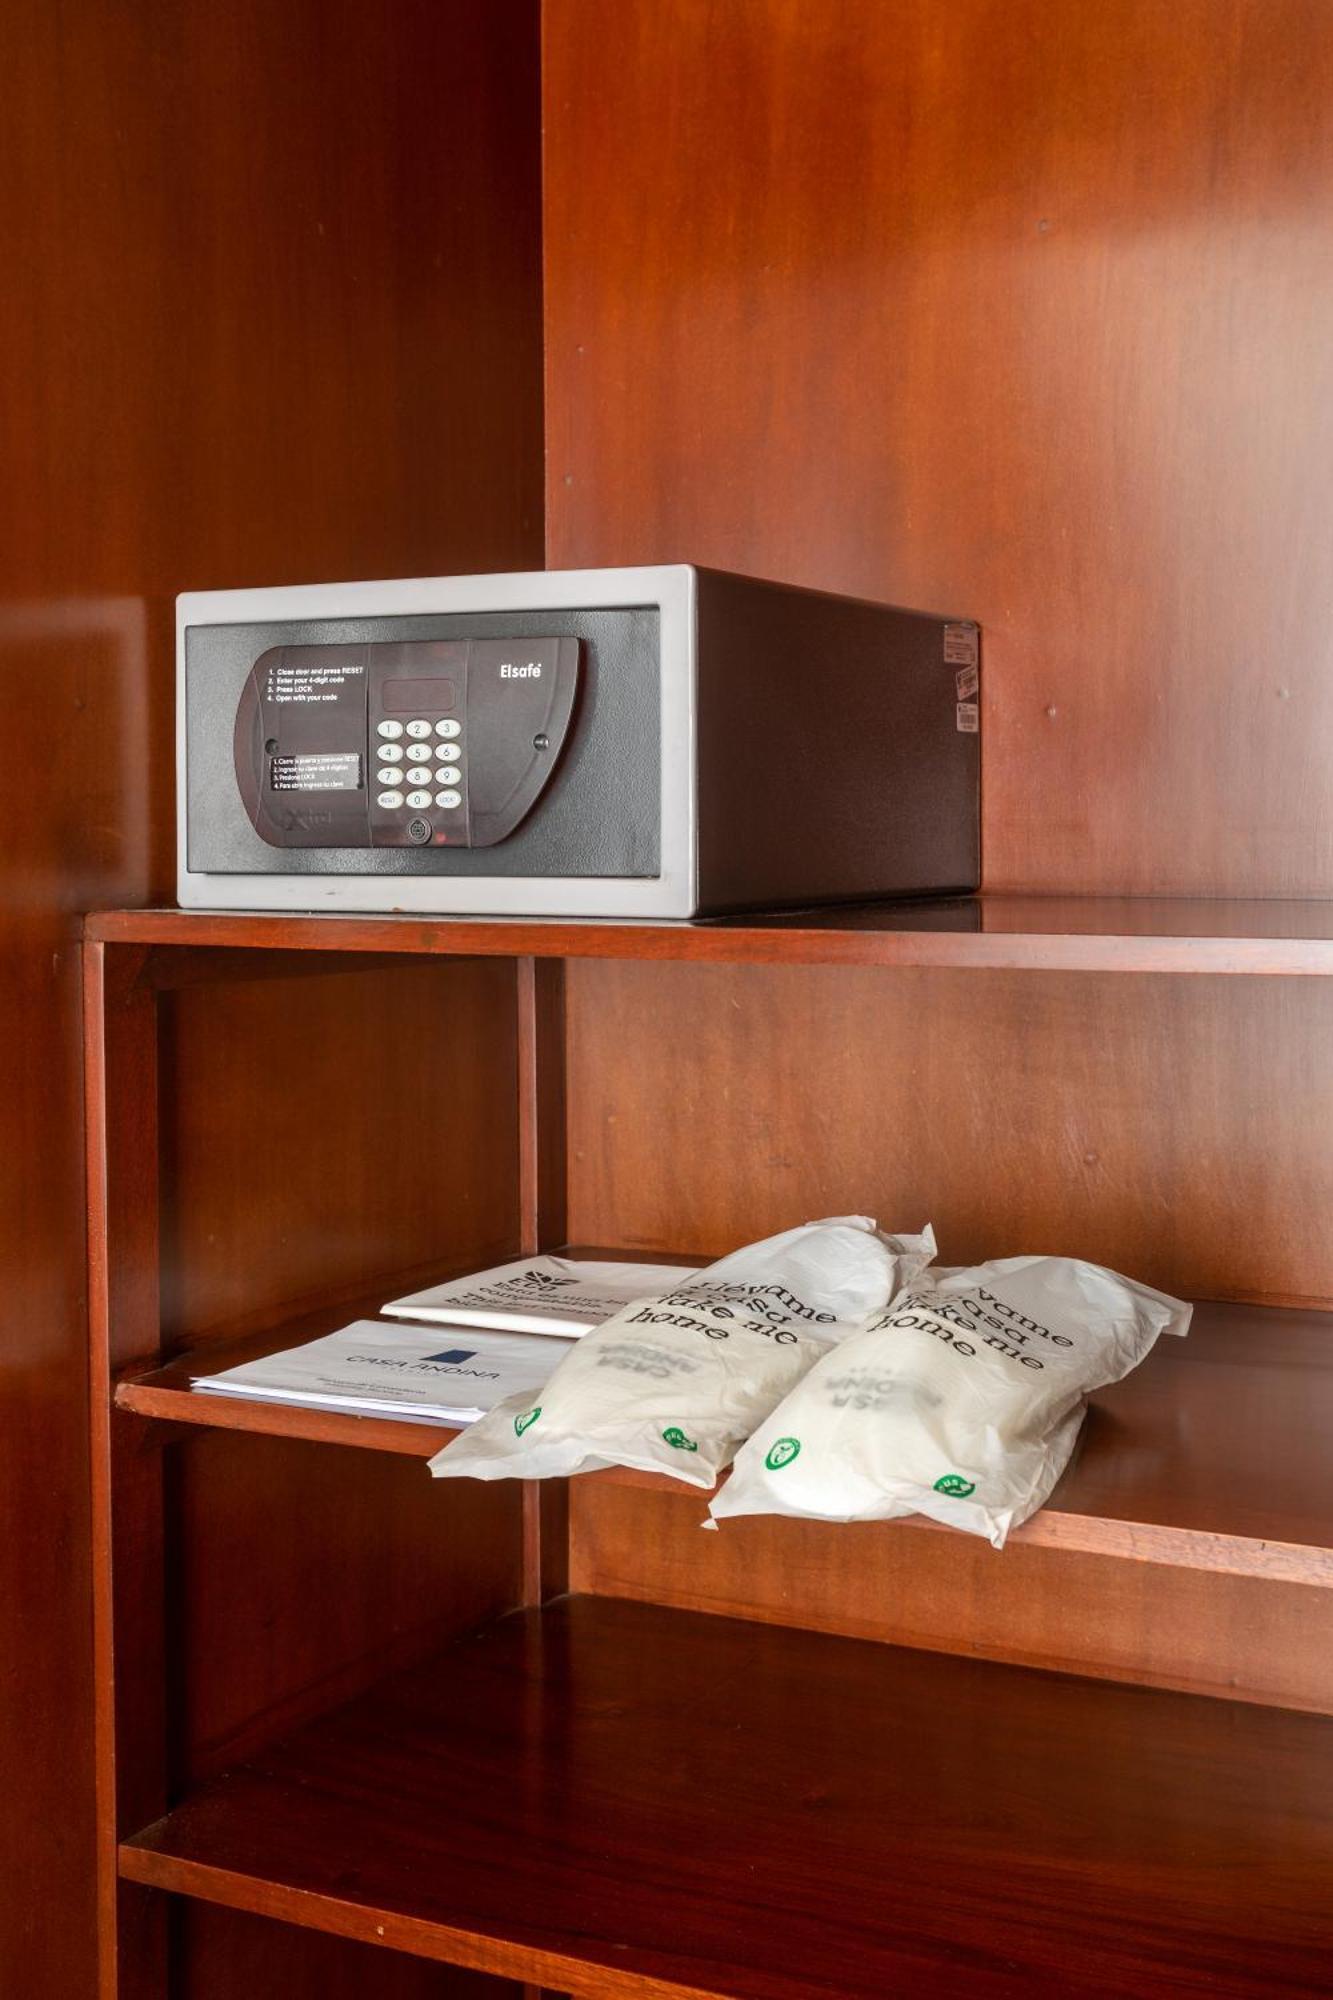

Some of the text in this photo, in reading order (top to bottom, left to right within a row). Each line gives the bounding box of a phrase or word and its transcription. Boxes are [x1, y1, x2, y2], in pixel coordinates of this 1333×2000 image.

[341, 666, 363, 674] RESET
[501, 664, 541, 678] Elsafe
[275, 695, 292, 703] Open
[414, 724, 421, 734] 2
[443, 723, 450, 733] 3
[385, 747, 450, 758] 4 5 6
[385, 771, 450, 780] 7 8 9
[414, 795, 421, 804] 0
[625, 1307, 730, 1340] home
[741, 1320, 798, 1345] me
[983, 1335, 1046, 1371] me
[346, 1355, 408, 1368] CASA
[410, 1363, 501, 1380] ANDINA
